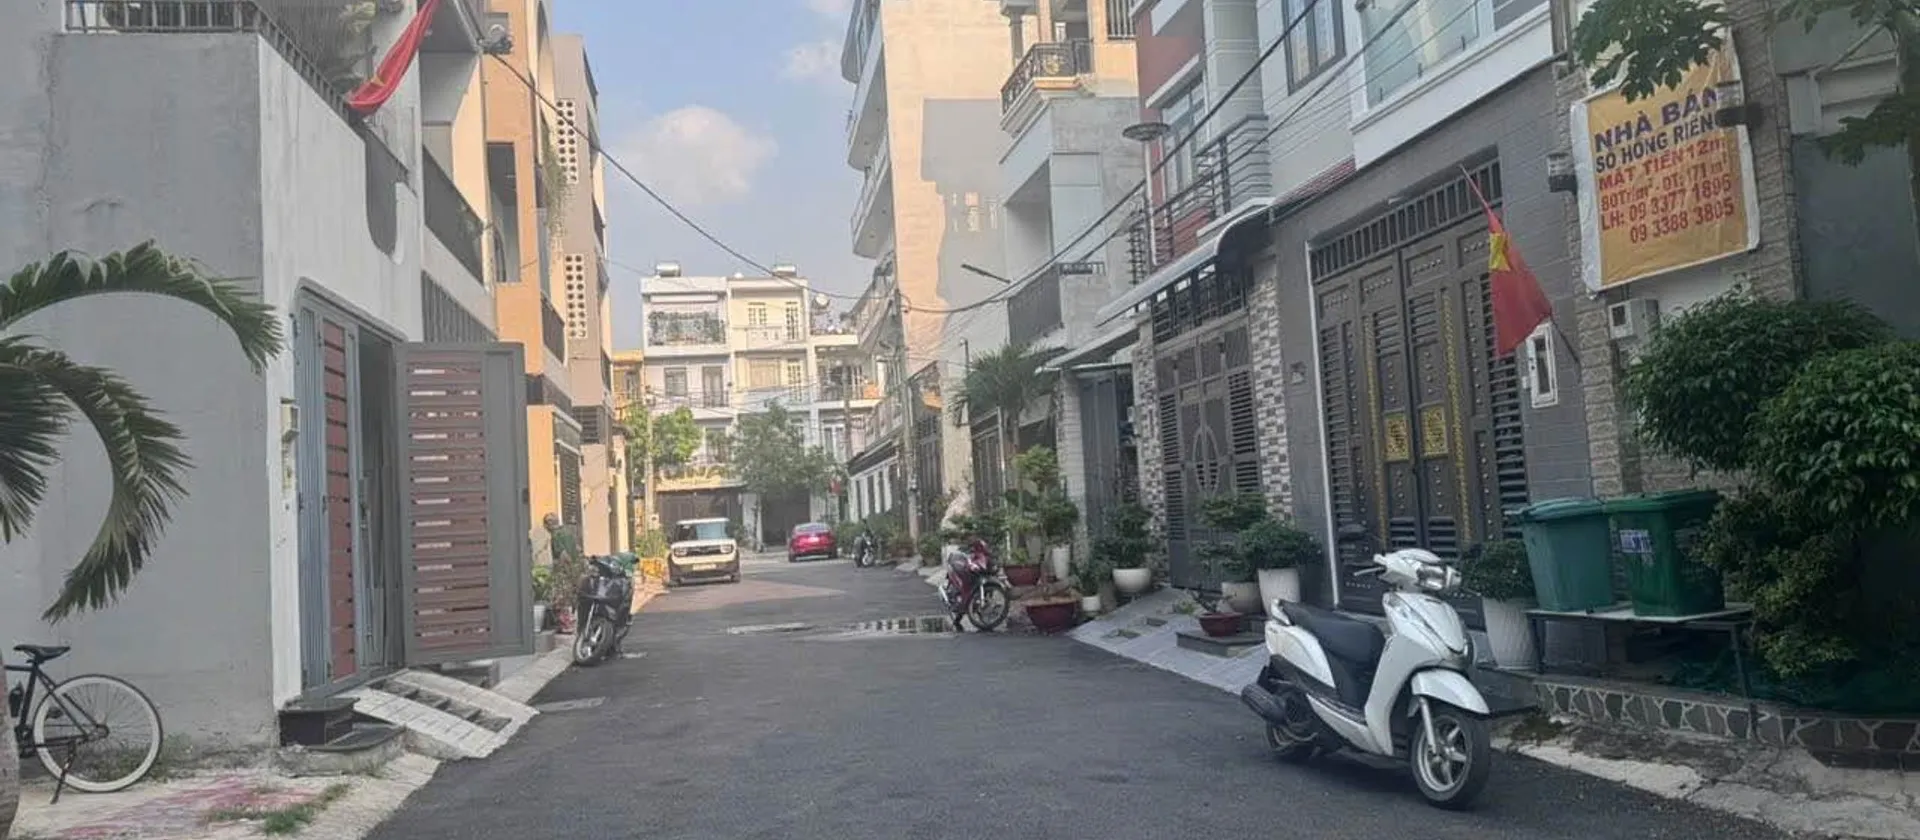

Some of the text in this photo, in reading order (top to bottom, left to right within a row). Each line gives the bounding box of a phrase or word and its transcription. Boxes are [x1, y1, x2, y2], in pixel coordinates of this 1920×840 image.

[1601, 210, 1625, 231] LH:
[1629, 202, 1647, 221] 09
[1651, 187, 1687, 215] 3377
[1630, 223, 1647, 244] 09
[1652, 210, 1689, 237] 3388
